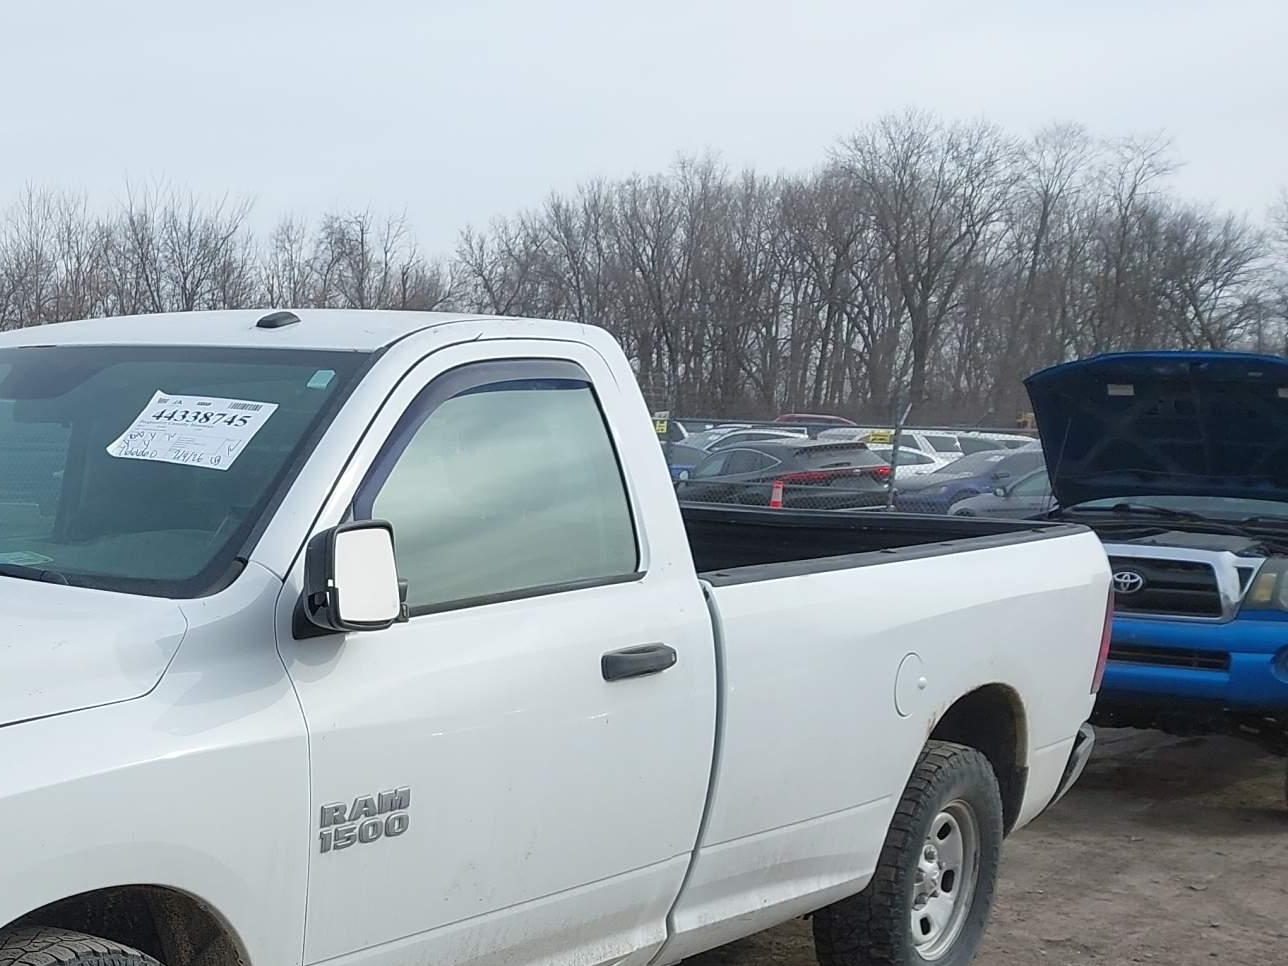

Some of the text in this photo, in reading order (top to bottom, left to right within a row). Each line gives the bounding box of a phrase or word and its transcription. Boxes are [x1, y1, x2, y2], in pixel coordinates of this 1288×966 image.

[152, 408, 252, 427] 44338745
[320, 785, 411, 829] RAM
[319, 811, 410, 854] 1500
